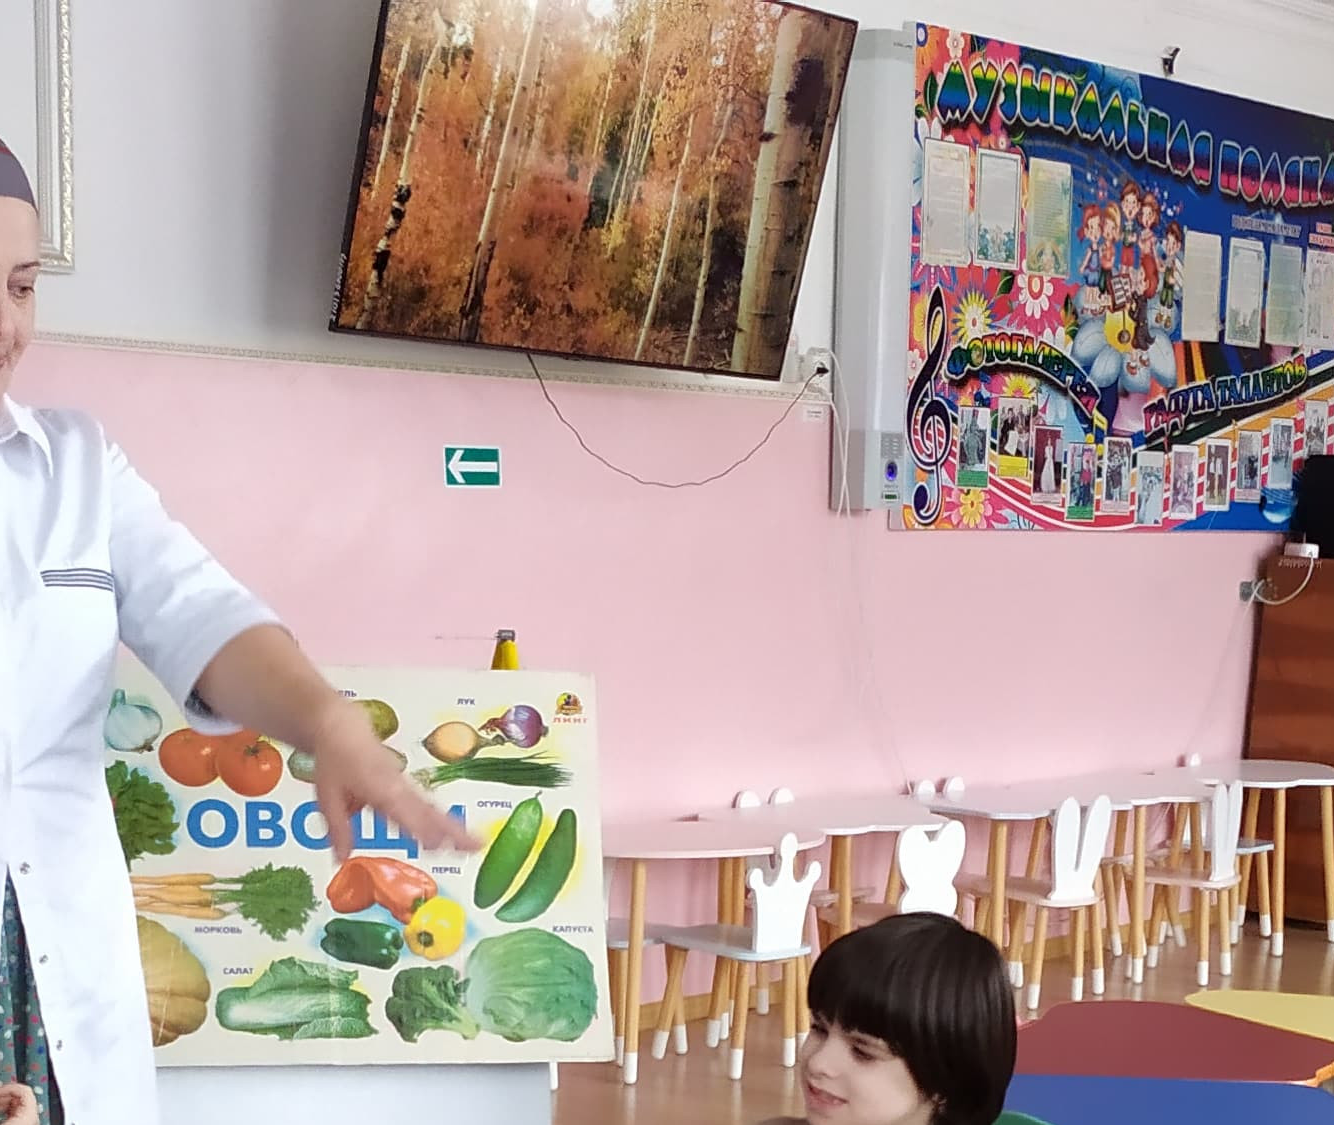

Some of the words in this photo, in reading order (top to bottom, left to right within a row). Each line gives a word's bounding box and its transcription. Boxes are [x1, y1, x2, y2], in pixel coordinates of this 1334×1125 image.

[936, 59, 1213, 185] МУЗЫКАЛЬНАЯ
[946, 332, 1101, 418] ФОТОГАЛЕРЕЯ
[477, 800, 512, 809] ОГУРЕЦ
[186, 798, 466, 859] ОВОЩ
[432, 866, 461, 874] ПЕРЕЦ
[194, 926, 242, 934] МОРКОВЬ
[553, 925, 594, 933] КАПУСТА
[223, 967, 253, 975] САЛАТ
